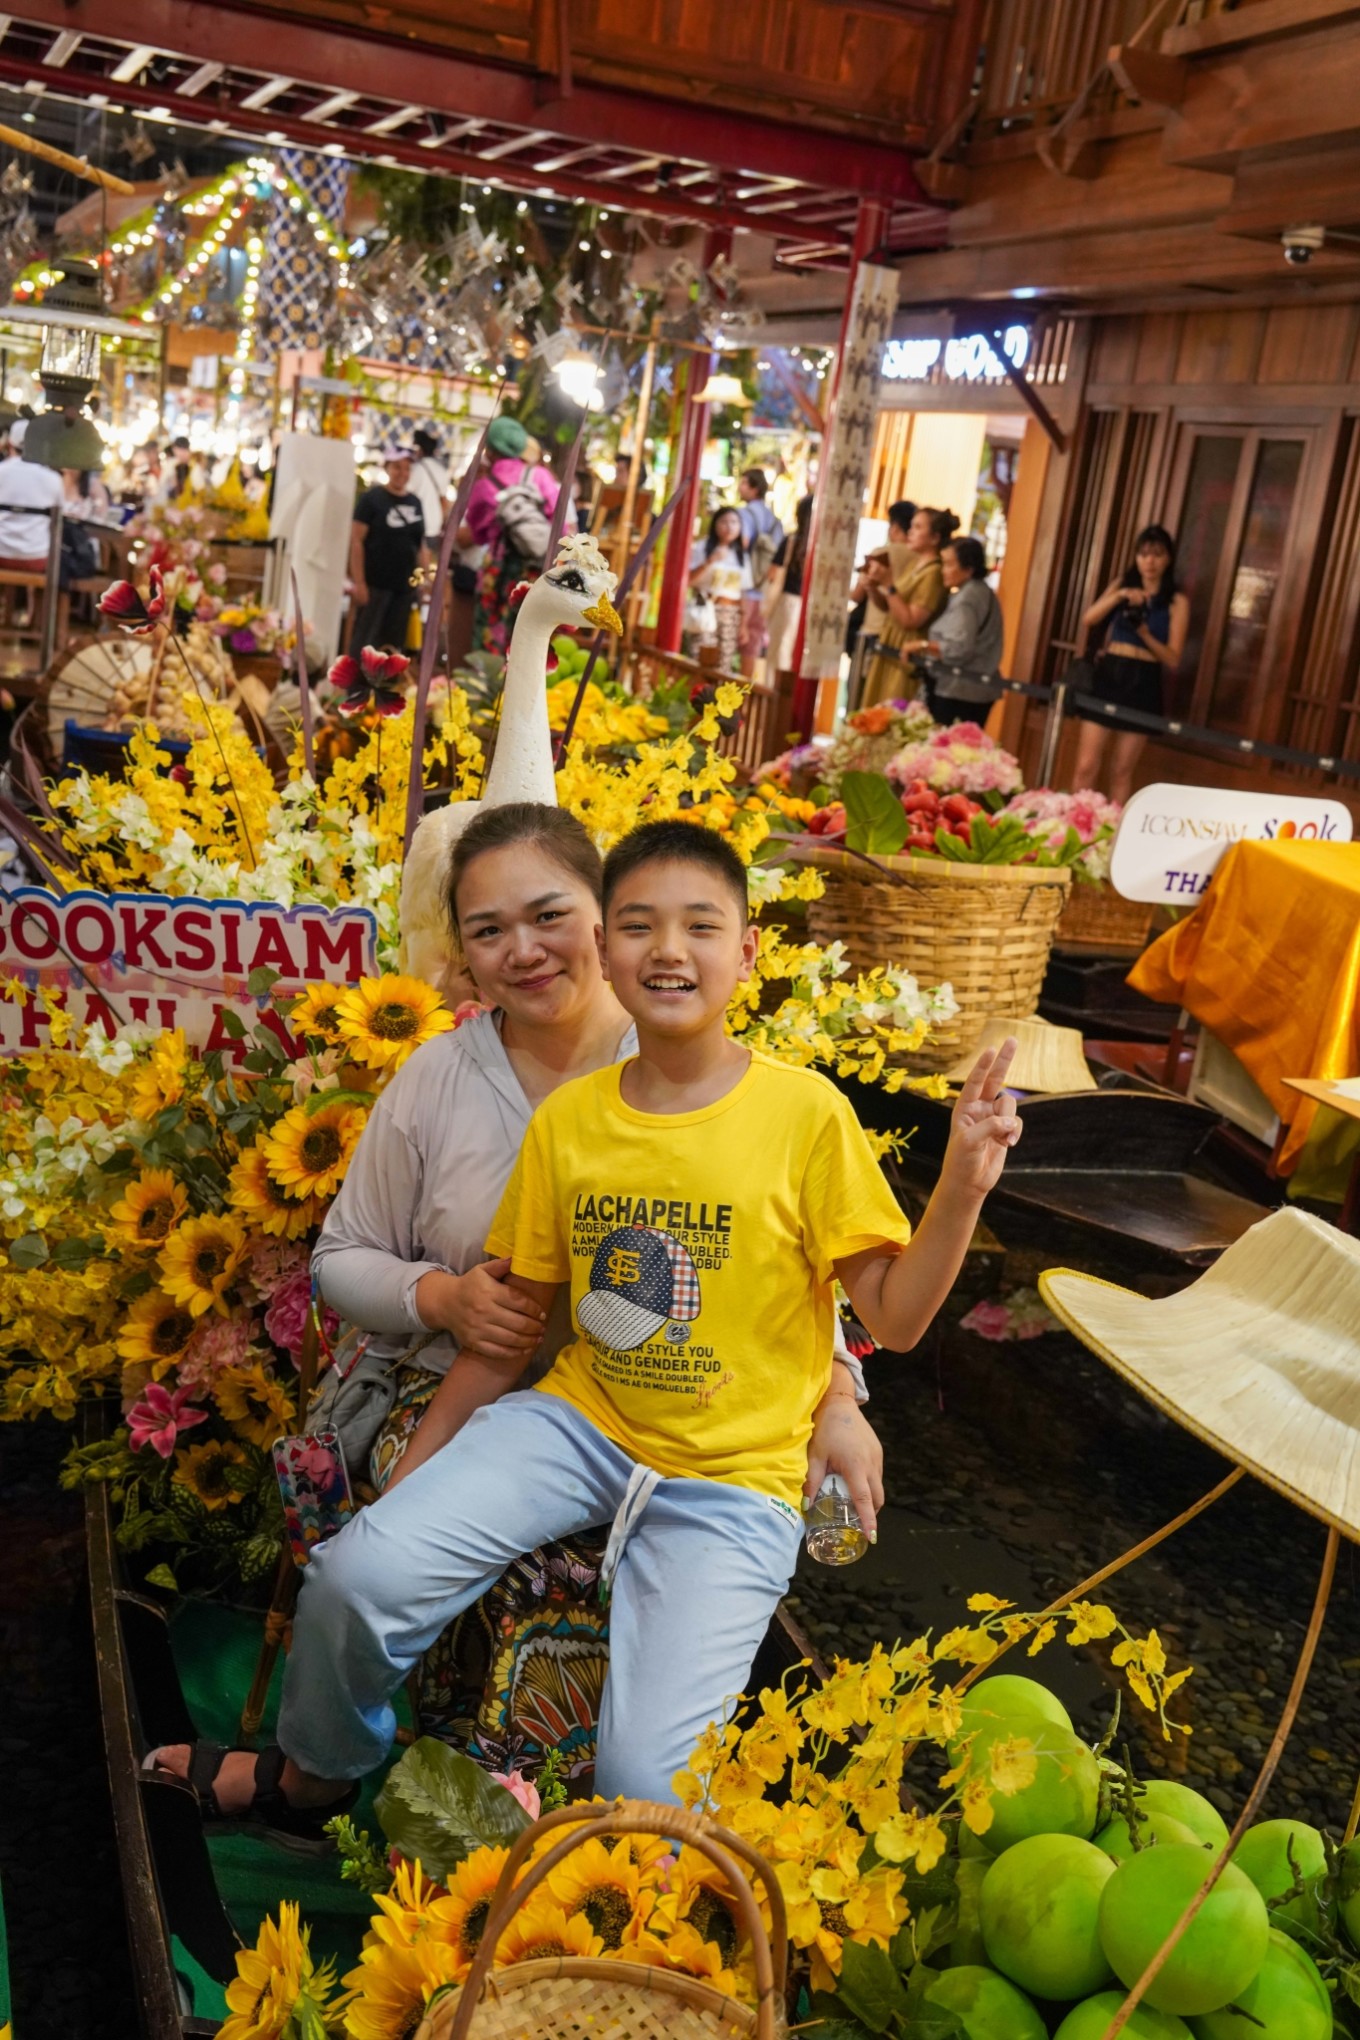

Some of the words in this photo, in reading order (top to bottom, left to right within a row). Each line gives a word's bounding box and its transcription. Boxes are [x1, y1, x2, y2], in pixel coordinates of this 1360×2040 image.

[1165, 870, 1213, 895] THA
[0, 900, 367, 982] OOKSIAM
[575, 1193, 733, 1233] LACHAPELLE
[571, 1235, 578, 1246] A
[692, 1231, 730, 1245] STYLE
[647, 1343, 685, 1357] STYLE
[688, 1346, 714, 1358] YOU
[610, 1352, 632, 1366] AND
[634, 1355, 690, 1372] GENDER
[693, 1360, 721, 1373] FUD
[634, 1369, 639, 1377] A
[640, 1370, 664, 1381] SMILE
[665, 1373, 707, 1383] DOUBLED.
